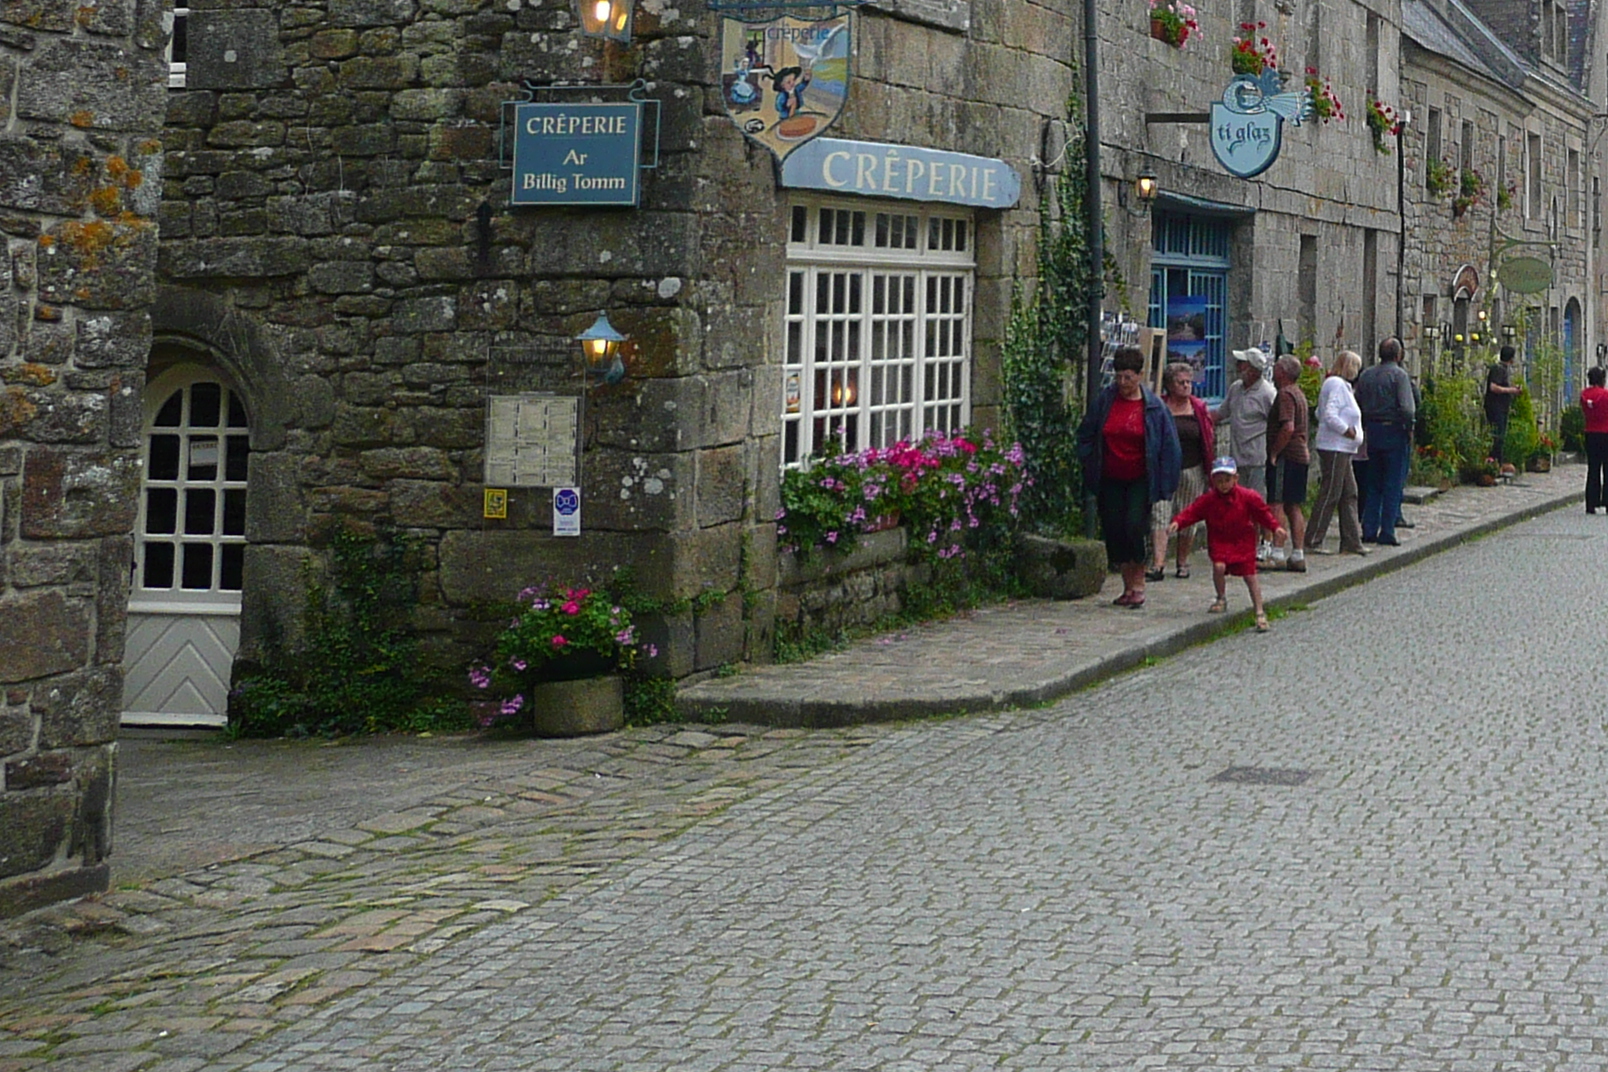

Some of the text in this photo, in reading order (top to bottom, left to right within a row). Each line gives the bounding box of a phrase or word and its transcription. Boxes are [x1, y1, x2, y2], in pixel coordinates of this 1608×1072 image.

[526, 113, 627, 134] CRÊPERIE
[1216, 121, 1271, 156] ti glaz
[562, 149, 588, 165] Ar
[523, 173, 626, 193] Billig Tomm
[822, 149, 998, 202] CRÊPERIE
